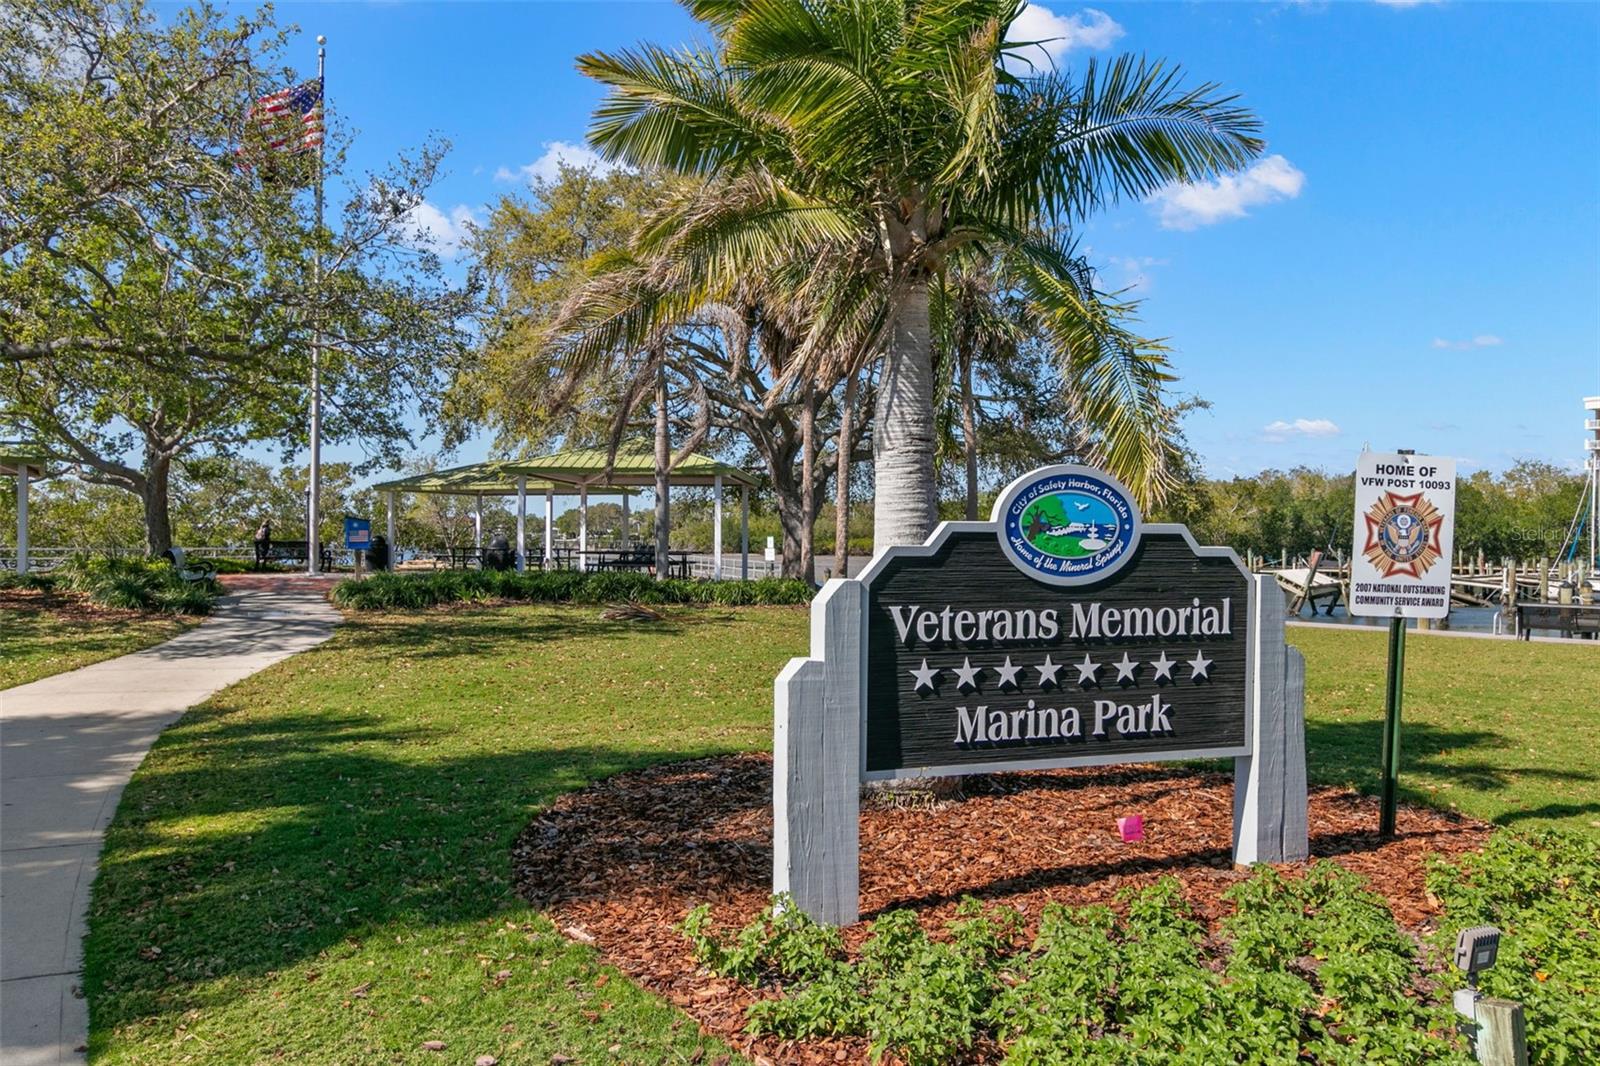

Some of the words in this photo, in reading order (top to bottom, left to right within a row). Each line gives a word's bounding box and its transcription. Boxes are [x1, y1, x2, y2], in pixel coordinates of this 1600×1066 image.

[1361, 477, 1385, 487] VFW
[1387, 479, 1416, 489] POST
[1419, 480, 1451, 490] 10093
[1376, 464, 1415, 477] HOME
[1419, 466, 1437, 478] OF
[1012, 495, 1027, 516] City
[1028, 486, 1038, 499] of
[1038, 480, 1066, 494] Safety
[1068, 478, 1102, 495] Harbor,
[1102, 488, 1128, 519] Florida
[1010, 536, 1032, 561] Home
[1033, 555, 1043, 569] of
[1044, 557, 1057, 572] the
[1059, 557, 1093, 572] Mineral
[1095, 538, 1124, 567] Springs
[1355, 583, 1372, 593] 2007
[1372, 583, 1402, 594] NATIONAL
[1403, 584, 1446, 595] OUTSTANDING
[1355, 595, 1394, 606] COMMUNITY
[1395, 596, 1420, 607] SERVICE
[1421, 596, 1444, 607] AWARD
[889, 604, 1058, 644] Veterans
[1069, 597, 1231, 639] Memorial
[954, 699, 1081, 744] Marina
[1092, 693, 1173, 736] Park
